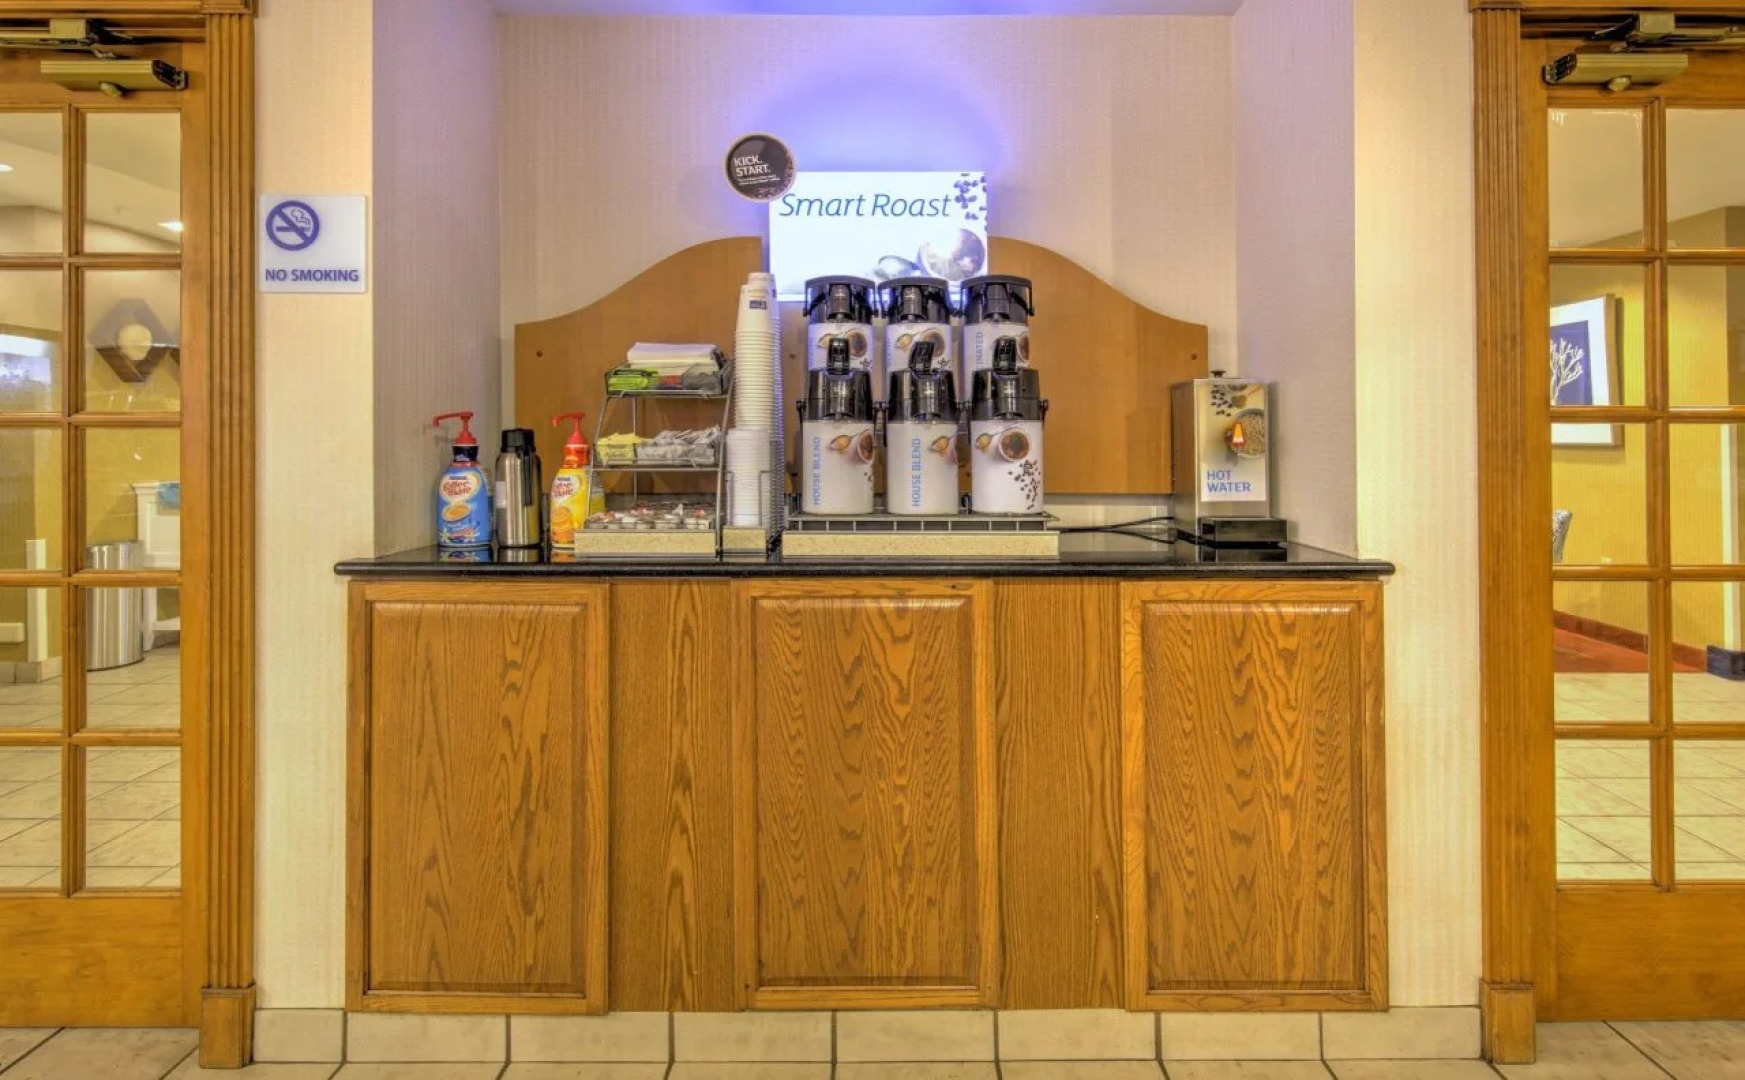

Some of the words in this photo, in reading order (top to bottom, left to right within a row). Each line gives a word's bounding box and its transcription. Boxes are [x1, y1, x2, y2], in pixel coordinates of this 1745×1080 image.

[734, 154, 763, 166] KICK.
[736, 164, 771, 177] START.
[779, 193, 866, 217] Smart
[871, 194, 952, 217] Roast
[265, 269, 287, 281] NO
[291, 269, 359, 281] SMOKING
[813, 436, 821, 470] BLEND
[911, 438, 921, 471] BLEND
[1207, 469, 1232, 481] HOT
[813, 473, 821, 506] HOUSE
[911, 474, 921, 507] HOUSE
[1207, 482, 1251, 493] WATER
